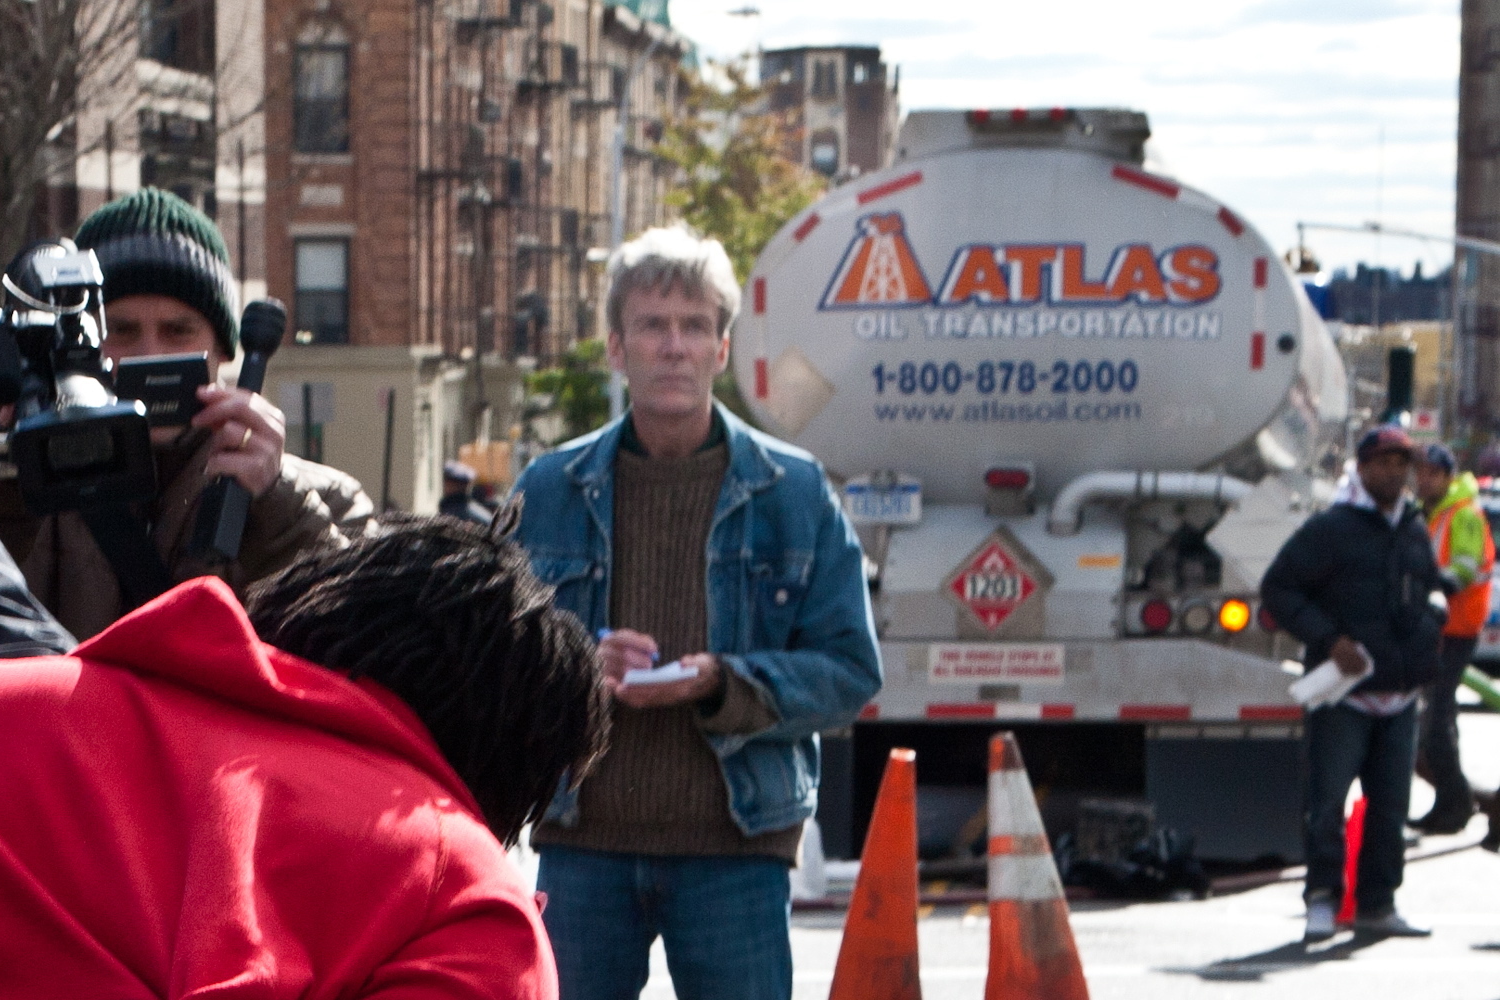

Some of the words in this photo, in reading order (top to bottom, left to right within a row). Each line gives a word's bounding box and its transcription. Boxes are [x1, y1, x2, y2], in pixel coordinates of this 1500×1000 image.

[934, 241, 1222, 308] ATLAS
[854, 310, 905, 339] OIL
[922, 309, 1222, 340] TRANSPORTATION
[872, 360, 1139, 394] 1-800-878-2000
[874, 400, 1142, 424] www.atlasoil.com
